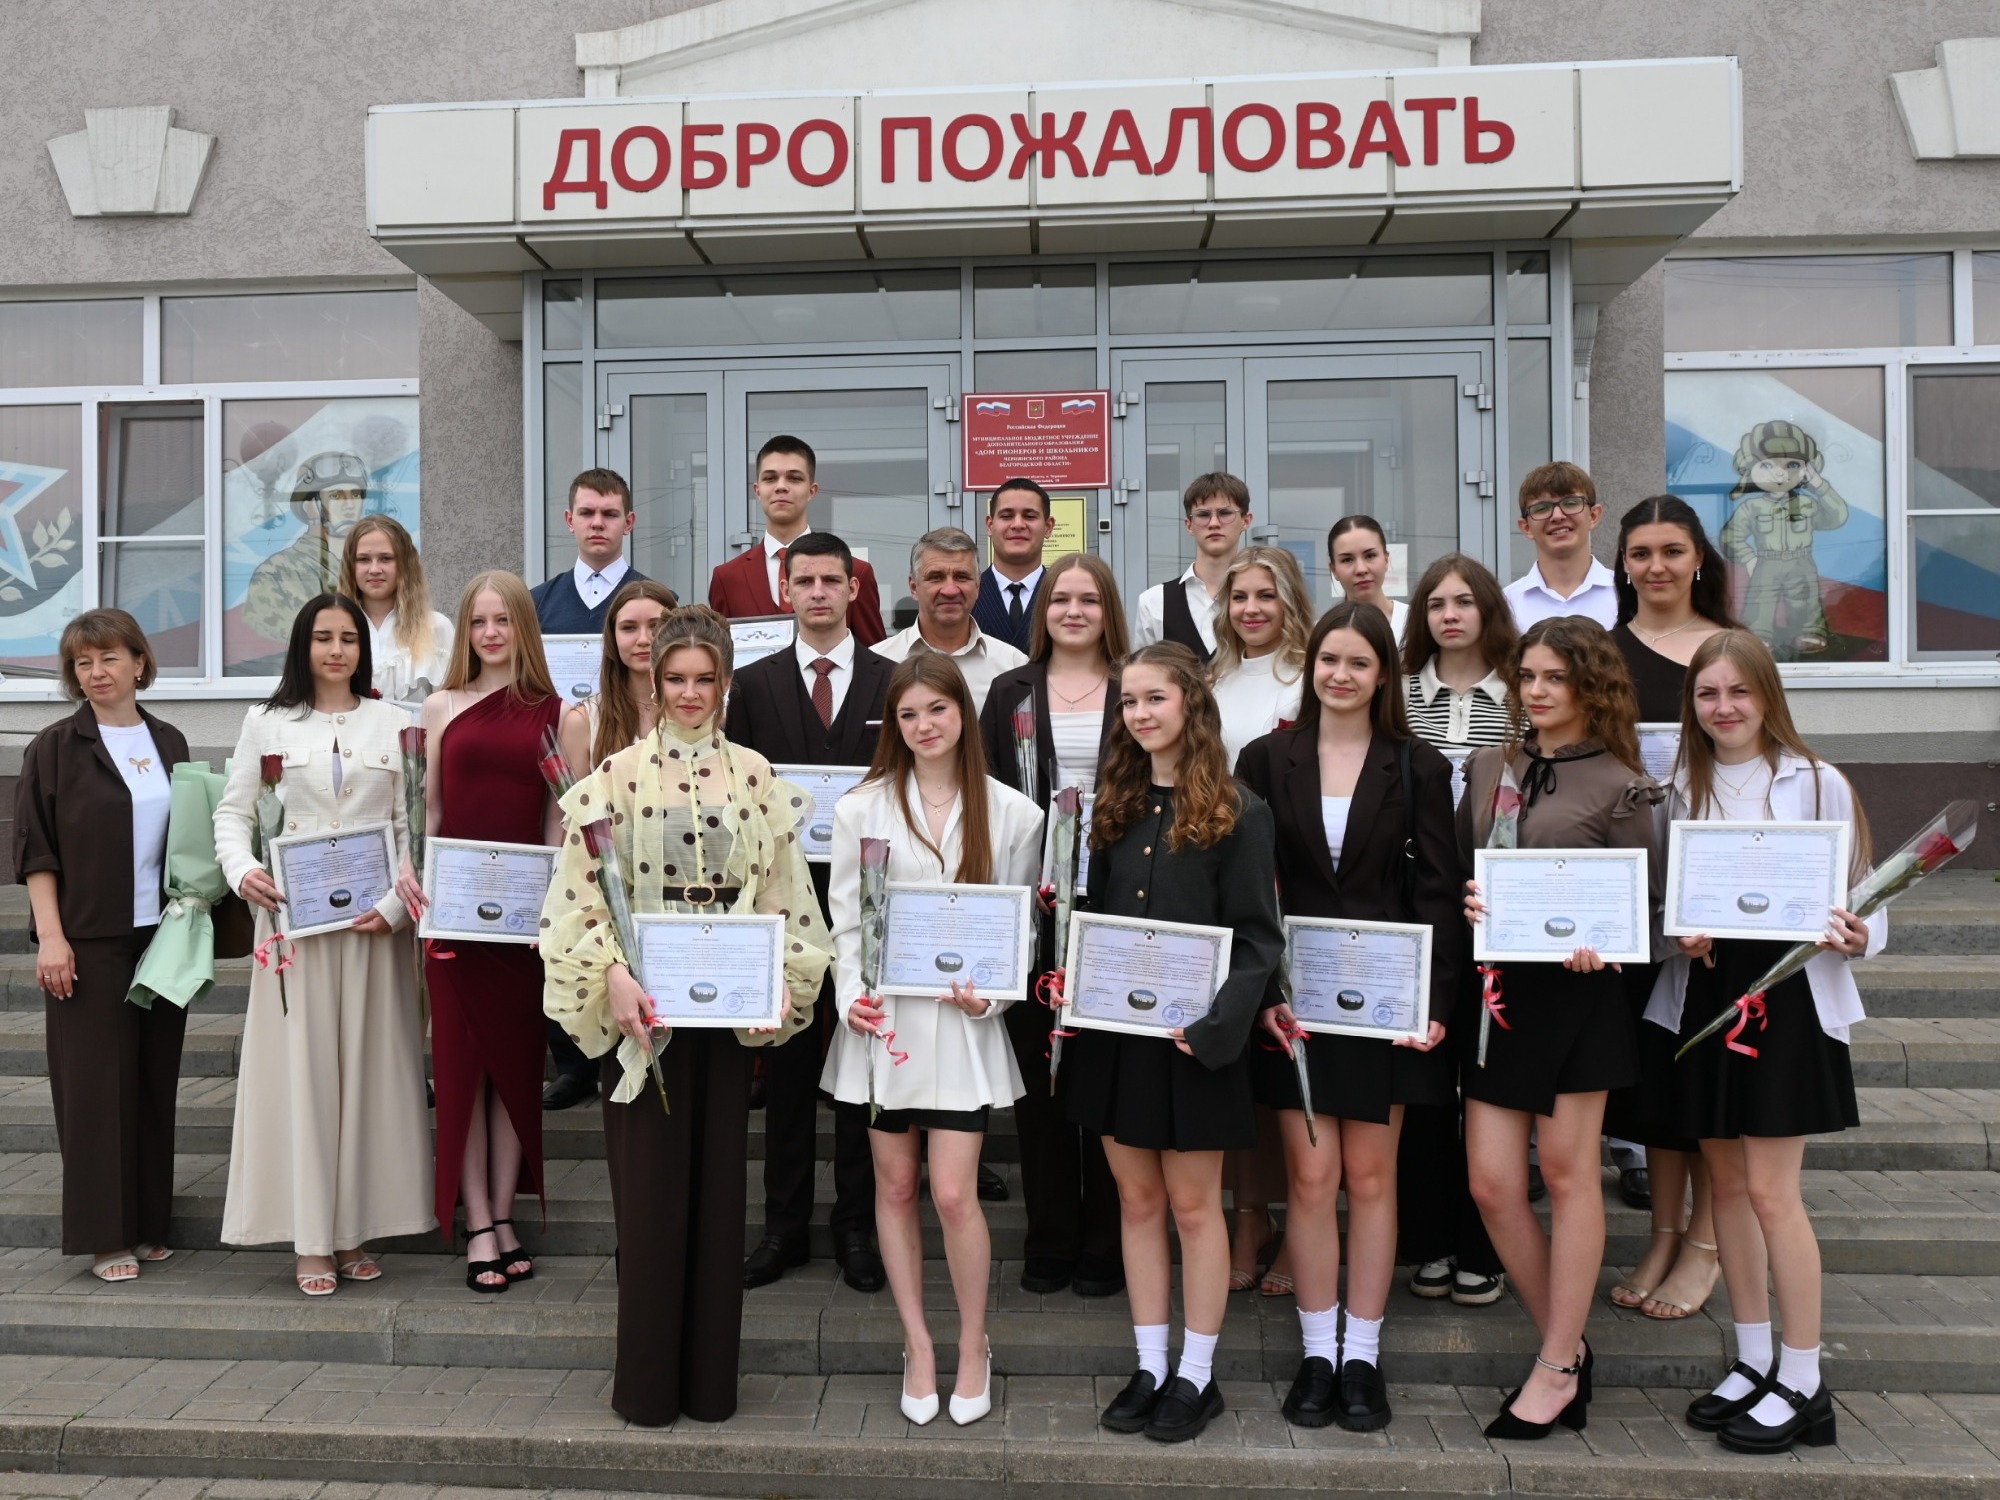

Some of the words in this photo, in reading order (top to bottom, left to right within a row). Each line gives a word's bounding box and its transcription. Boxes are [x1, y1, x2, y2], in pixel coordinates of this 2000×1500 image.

[543, 118, 849, 211] ДОБРО
[881, 96, 1516, 184] ПОЖАЛОВАТЬ
[1046, 446, 1099, 454] ШКОЛЬНИКОВ
